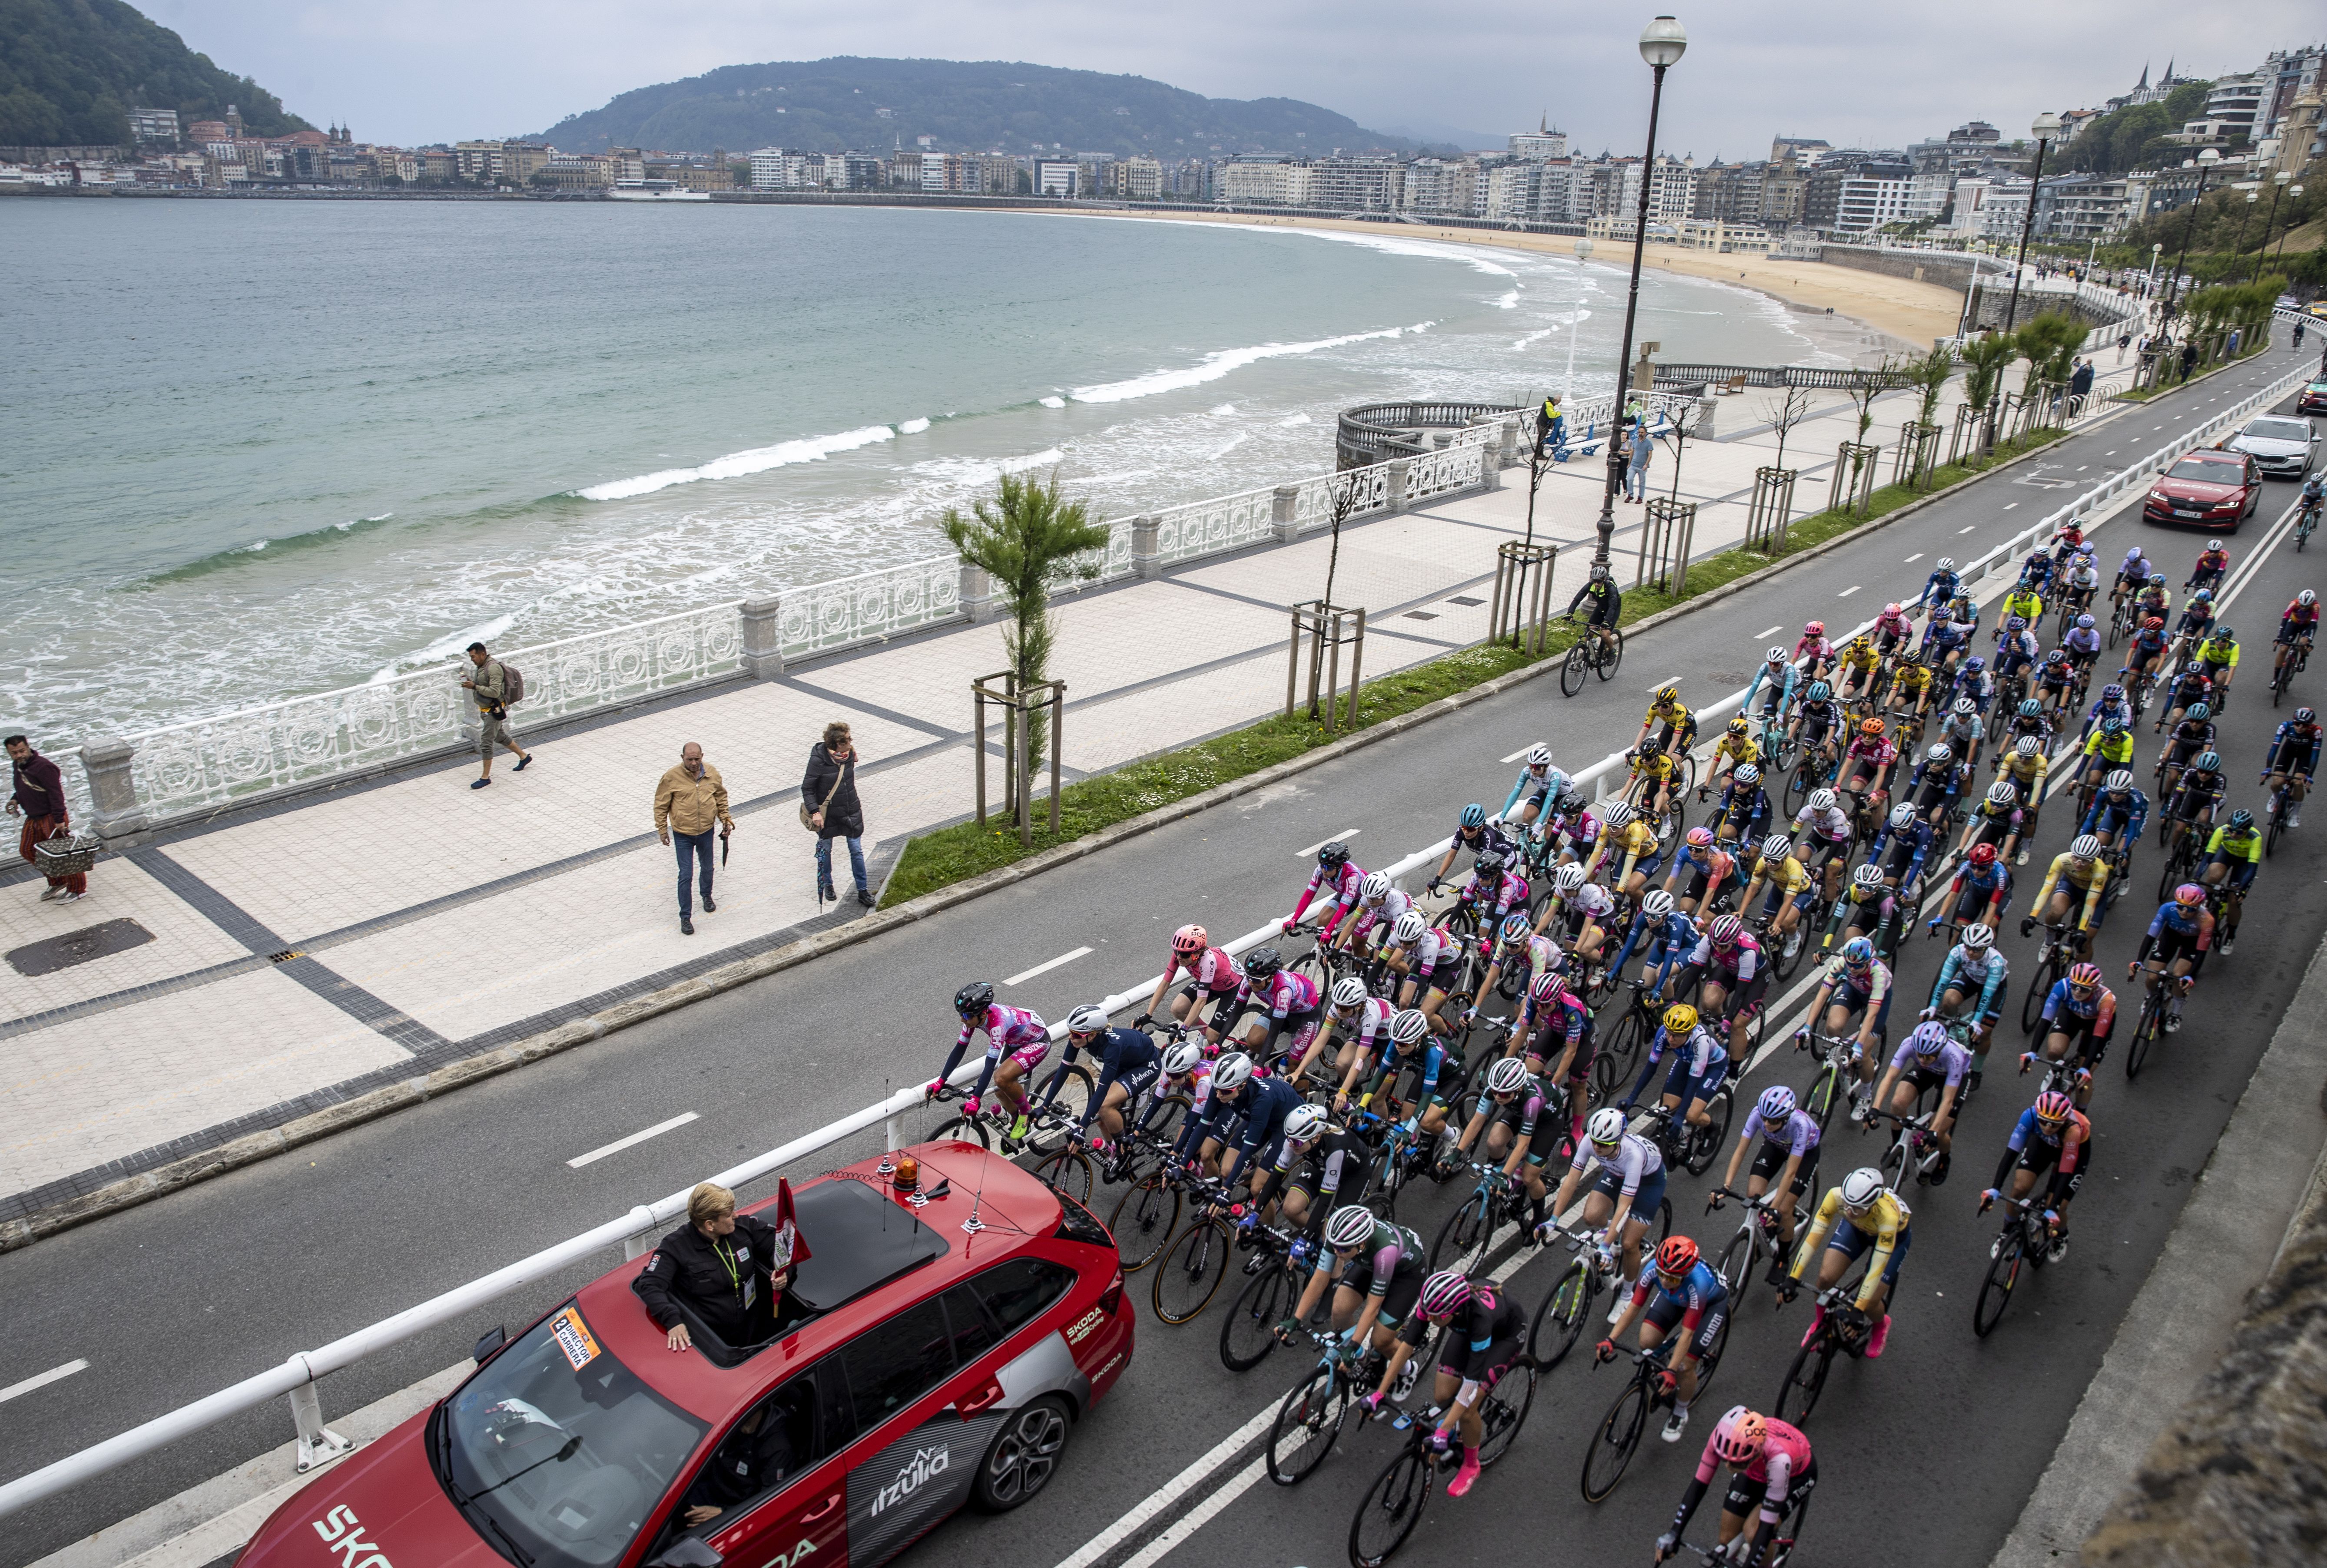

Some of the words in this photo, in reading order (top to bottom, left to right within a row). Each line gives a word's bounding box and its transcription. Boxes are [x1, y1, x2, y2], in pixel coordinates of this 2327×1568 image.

[2171, 483, 2223, 493] SKODA
[1682, 733, 1693, 747] JUMBO
[1299, 1022, 1314, 1049] Bizkaia
[1137, 1069, 1154, 1082] sdworx
[1226, 1112, 1237, 1129] sdwor
[1268, 1227, 1289, 1241] CANYON
[555, 1319, 567, 1330] 2
[1067, 1307, 1102, 1338] SKODA
[1089, 1317, 1104, 1331] Cycling
[1700, 1313, 1723, 1347] CERATIZIT
[559, 1332, 581, 1365] CARRERA
[566, 1324, 590, 1361] DIRECTOR
[1092, 1353, 1122, 1384] SKODA
[1335, 1403, 1346, 1432] MAVIC
[1729, 1490, 1750, 1503] EF
